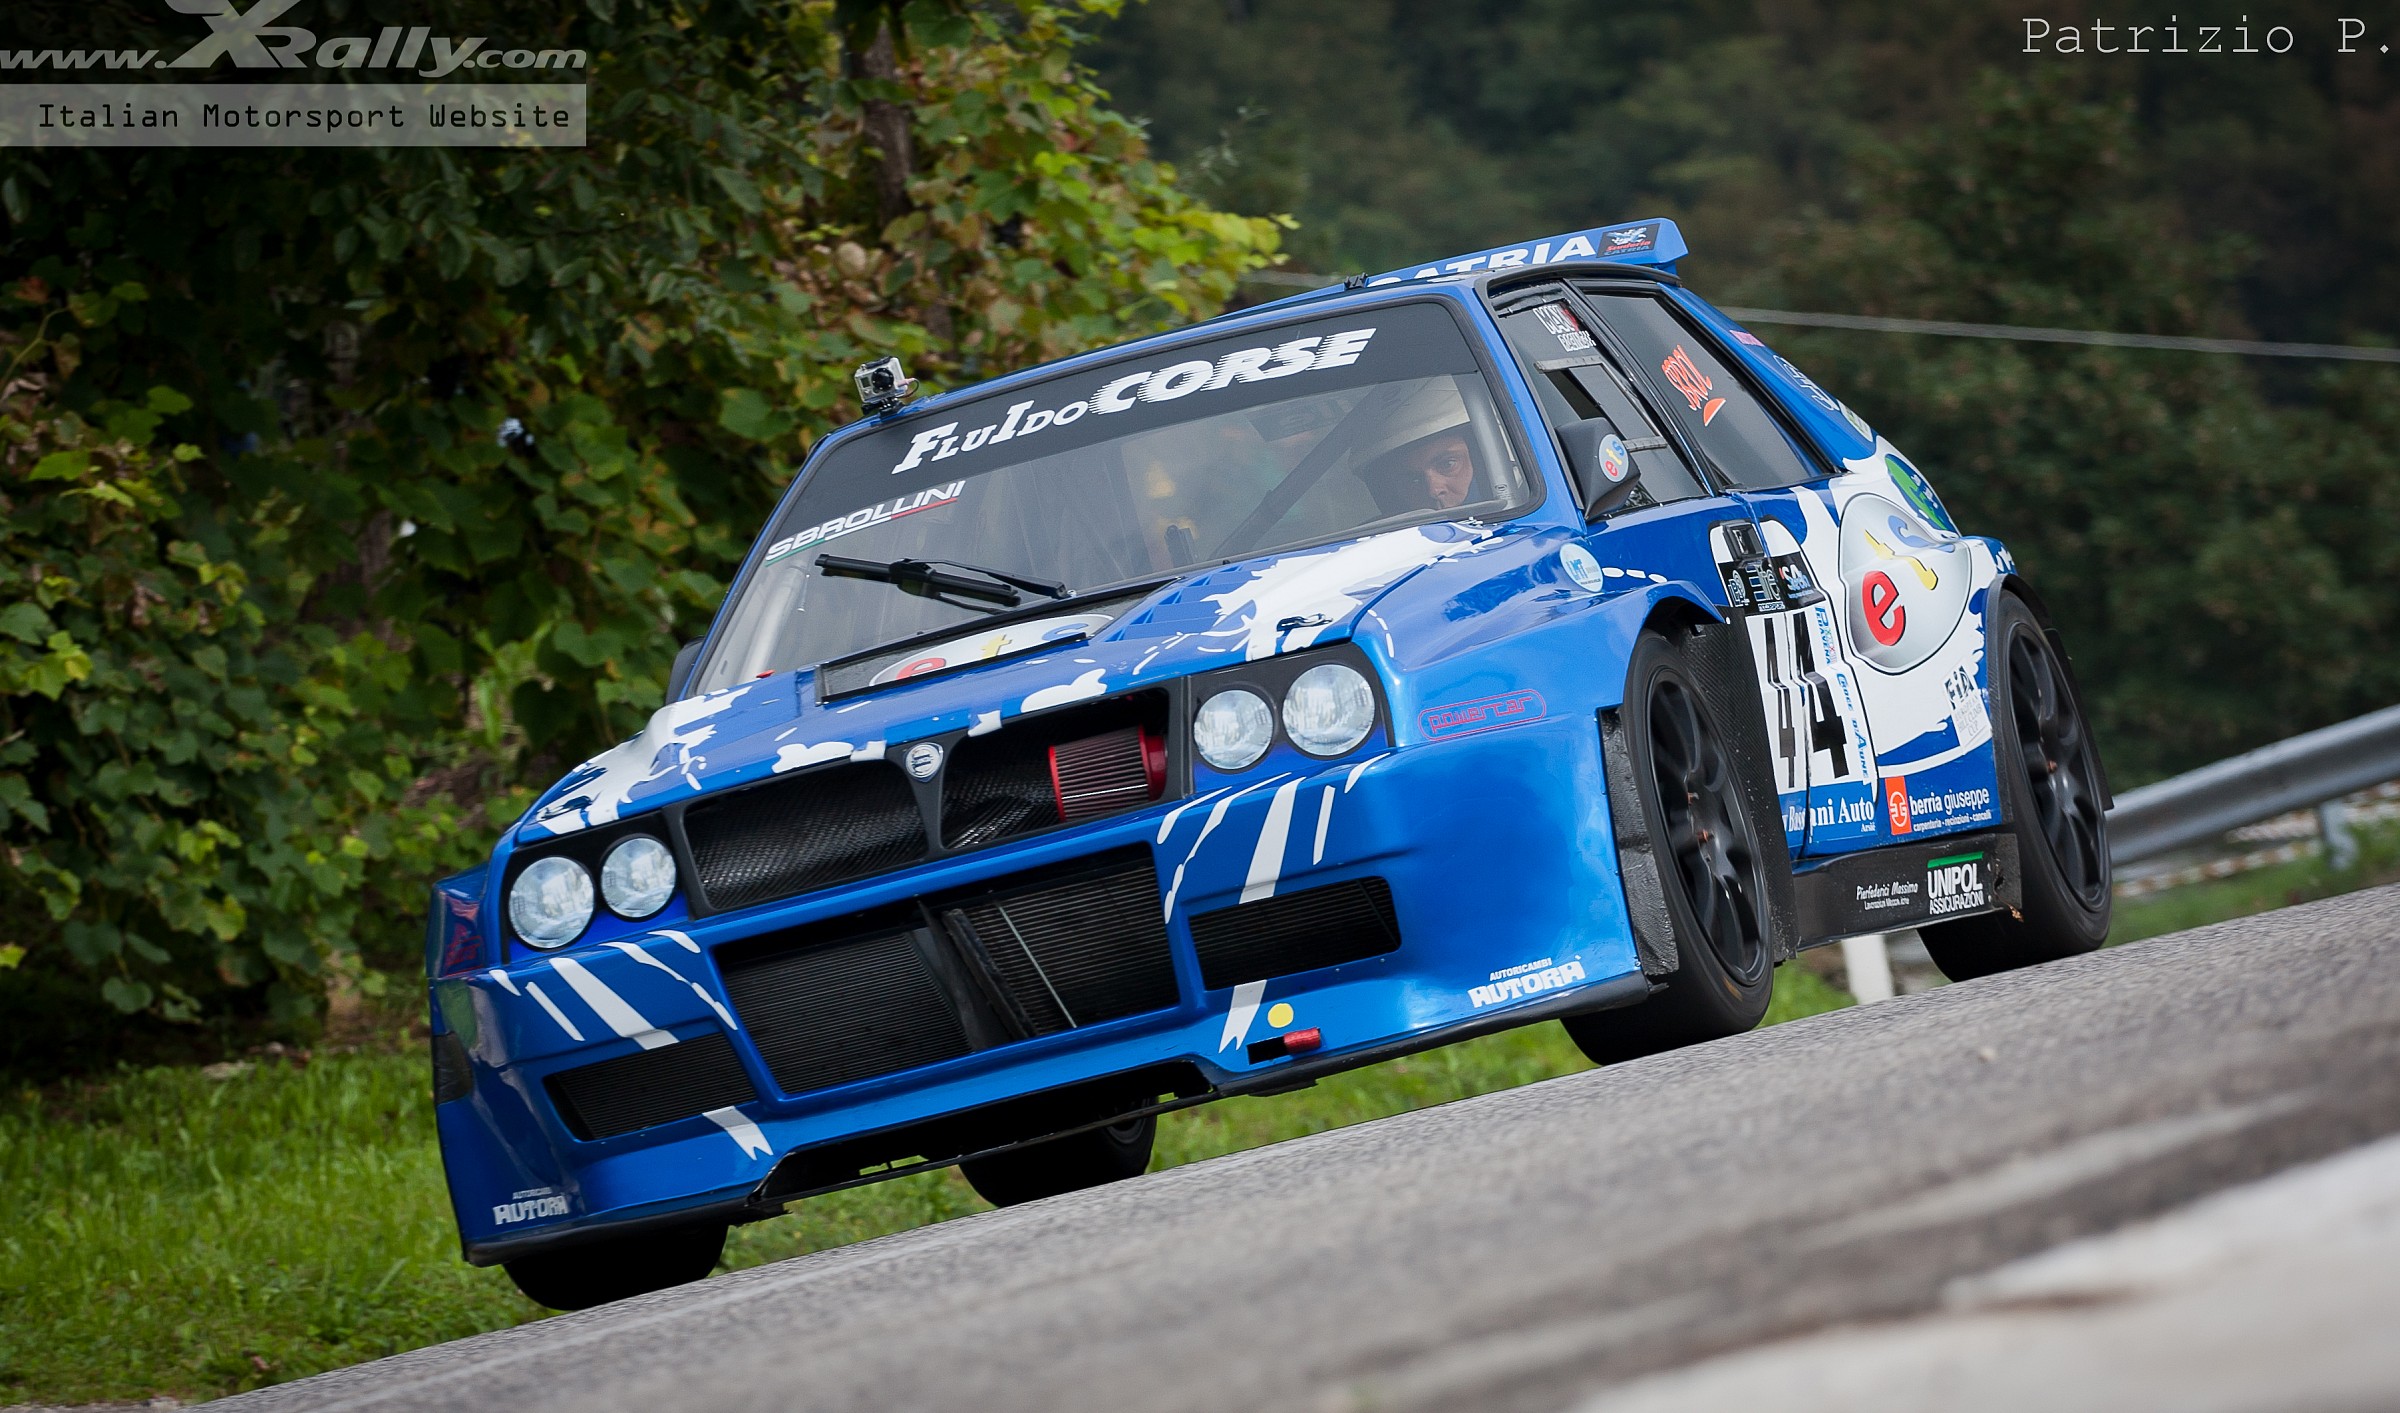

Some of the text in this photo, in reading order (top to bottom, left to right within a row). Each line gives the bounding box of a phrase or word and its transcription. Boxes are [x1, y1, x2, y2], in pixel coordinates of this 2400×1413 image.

[765, 480, 966, 561] SBROLLINI
[1837, 796, 1875, 824] Auto
[1909, 788, 1990, 816] berria giuseppe
[1927, 863, 1983, 899] UNIPOL
[1929, 890, 1985, 915] ASSICURAZIONI
[1489, 957, 1553, 982] AUTORICAMBI
